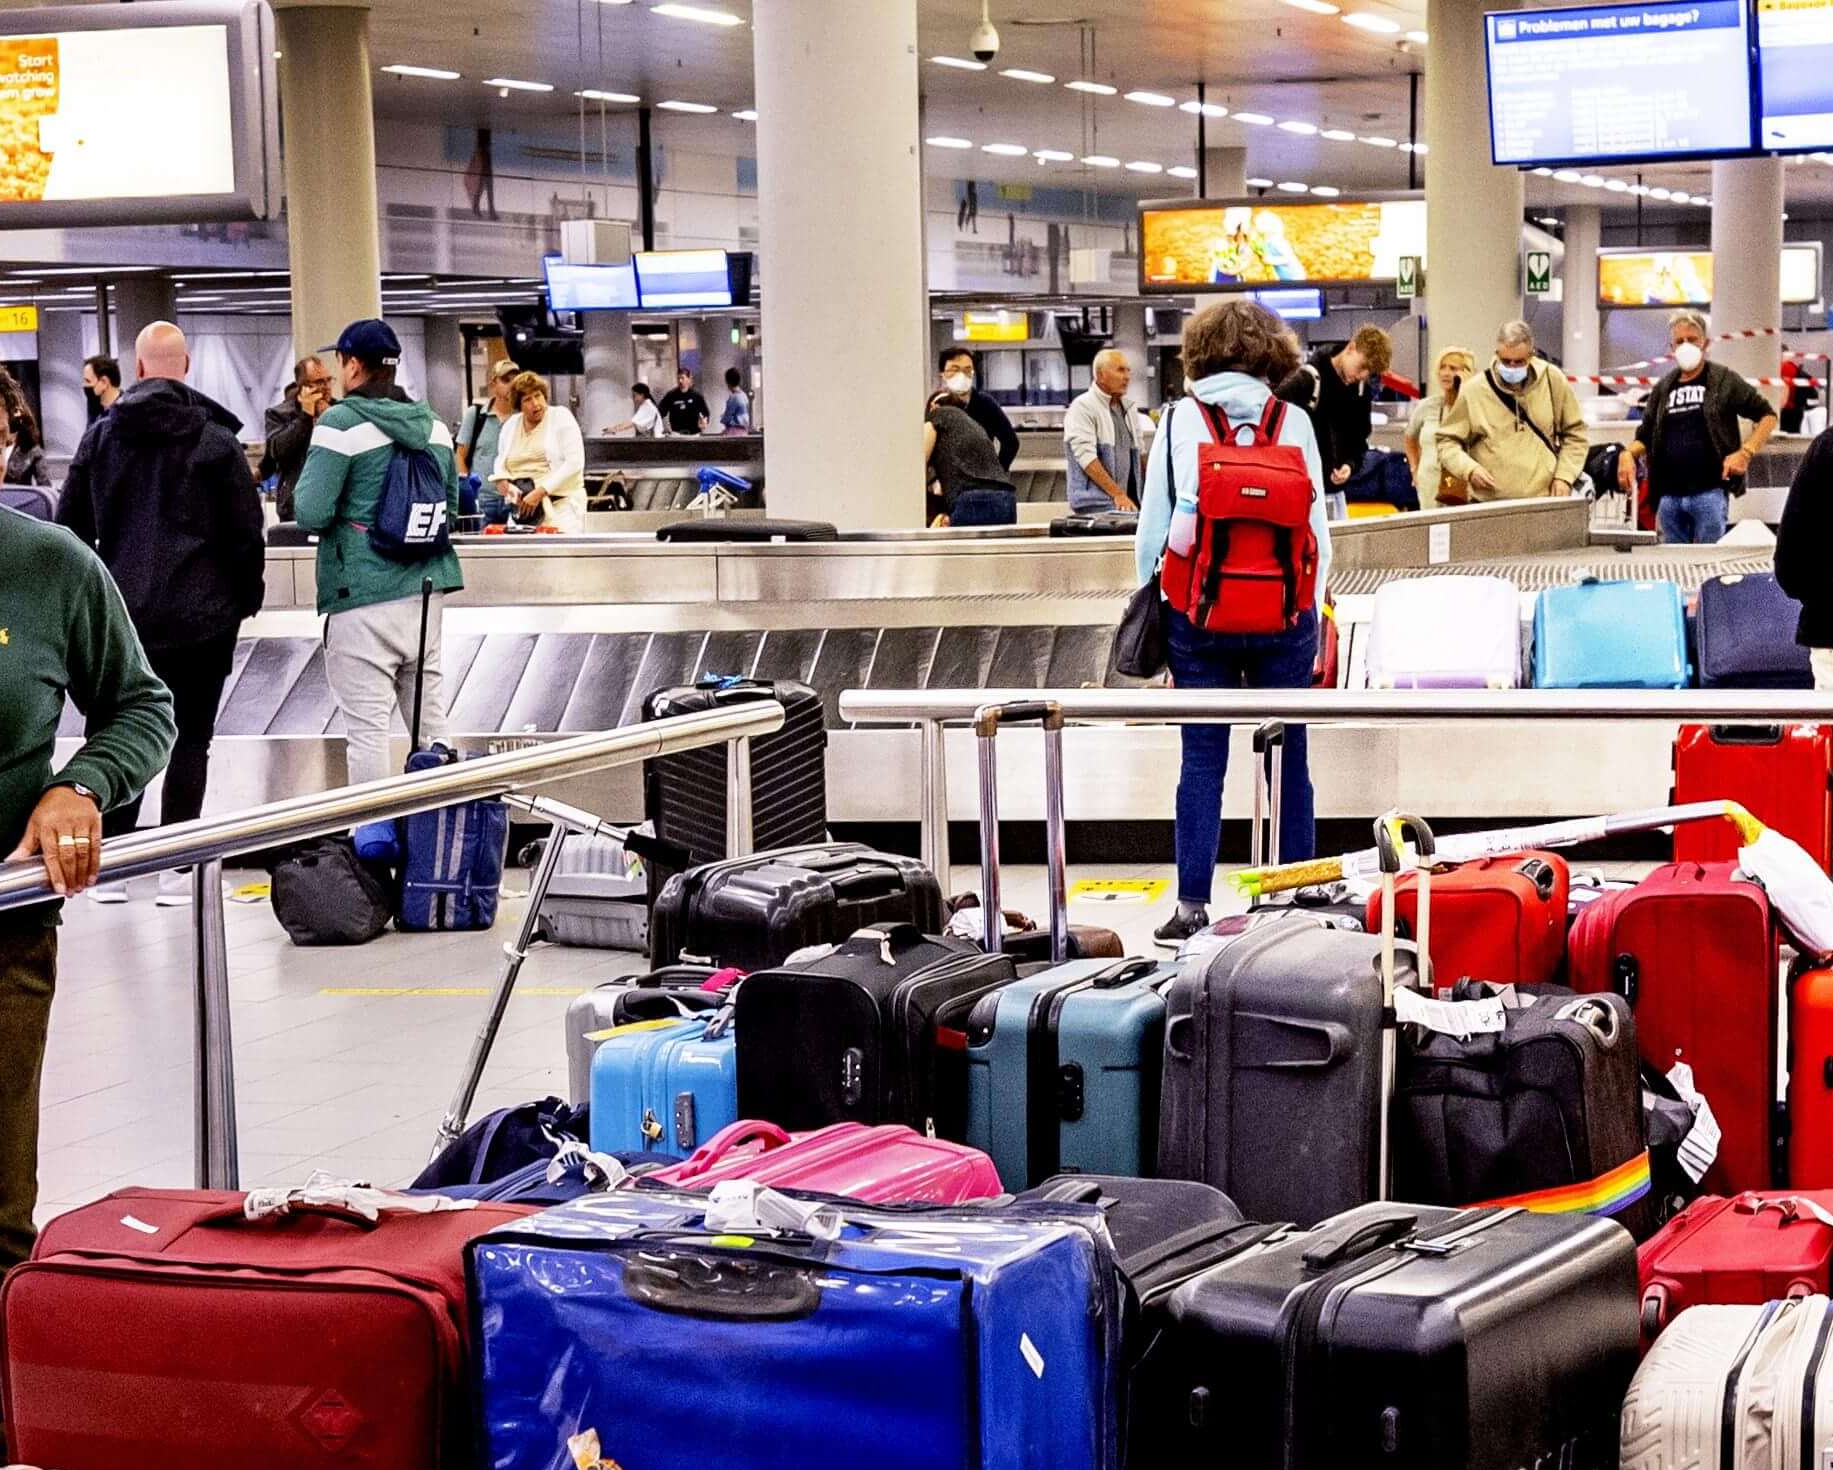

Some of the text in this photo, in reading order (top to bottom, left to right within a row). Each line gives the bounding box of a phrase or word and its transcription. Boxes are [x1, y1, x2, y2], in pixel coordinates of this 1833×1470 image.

[1518, 11, 1700, 35] Problemen met uw bagage?
[18, 54, 54, 67] Start
[22, 88, 56, 100] grow
[1528, 281, 1549, 290] AED
[12, 311, 29, 326] 16
[405, 500, 447, 538] EF
